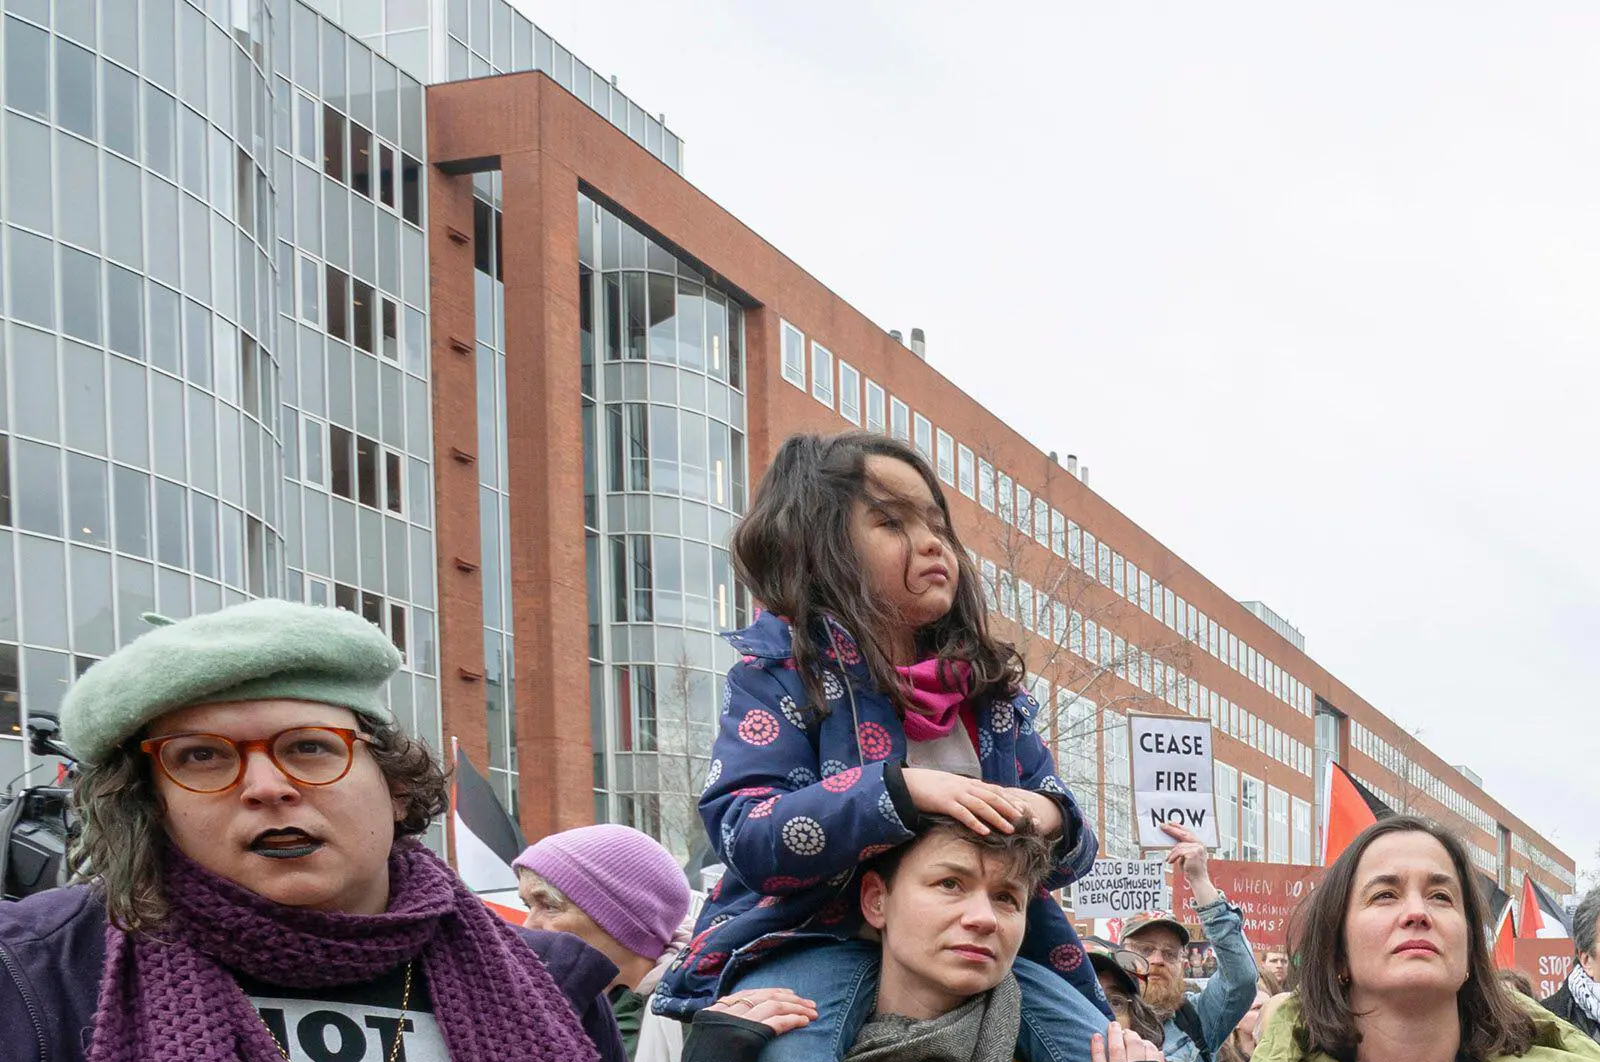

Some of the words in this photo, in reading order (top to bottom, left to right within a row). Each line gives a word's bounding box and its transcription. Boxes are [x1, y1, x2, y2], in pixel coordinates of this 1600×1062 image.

[1140, 732, 1203, 756] CEASE
[1156, 771, 1197, 792] FIRE
[1151, 808, 1206, 828] NOW
[1143, 861, 1163, 876] HET
[1233, 878, 1273, 896] WHEN
[1285, 879, 1303, 897] DO
[1079, 895, 1088, 905] IS
[1091, 892, 1109, 904] EEN
[1539, 955, 1571, 978] STOP
